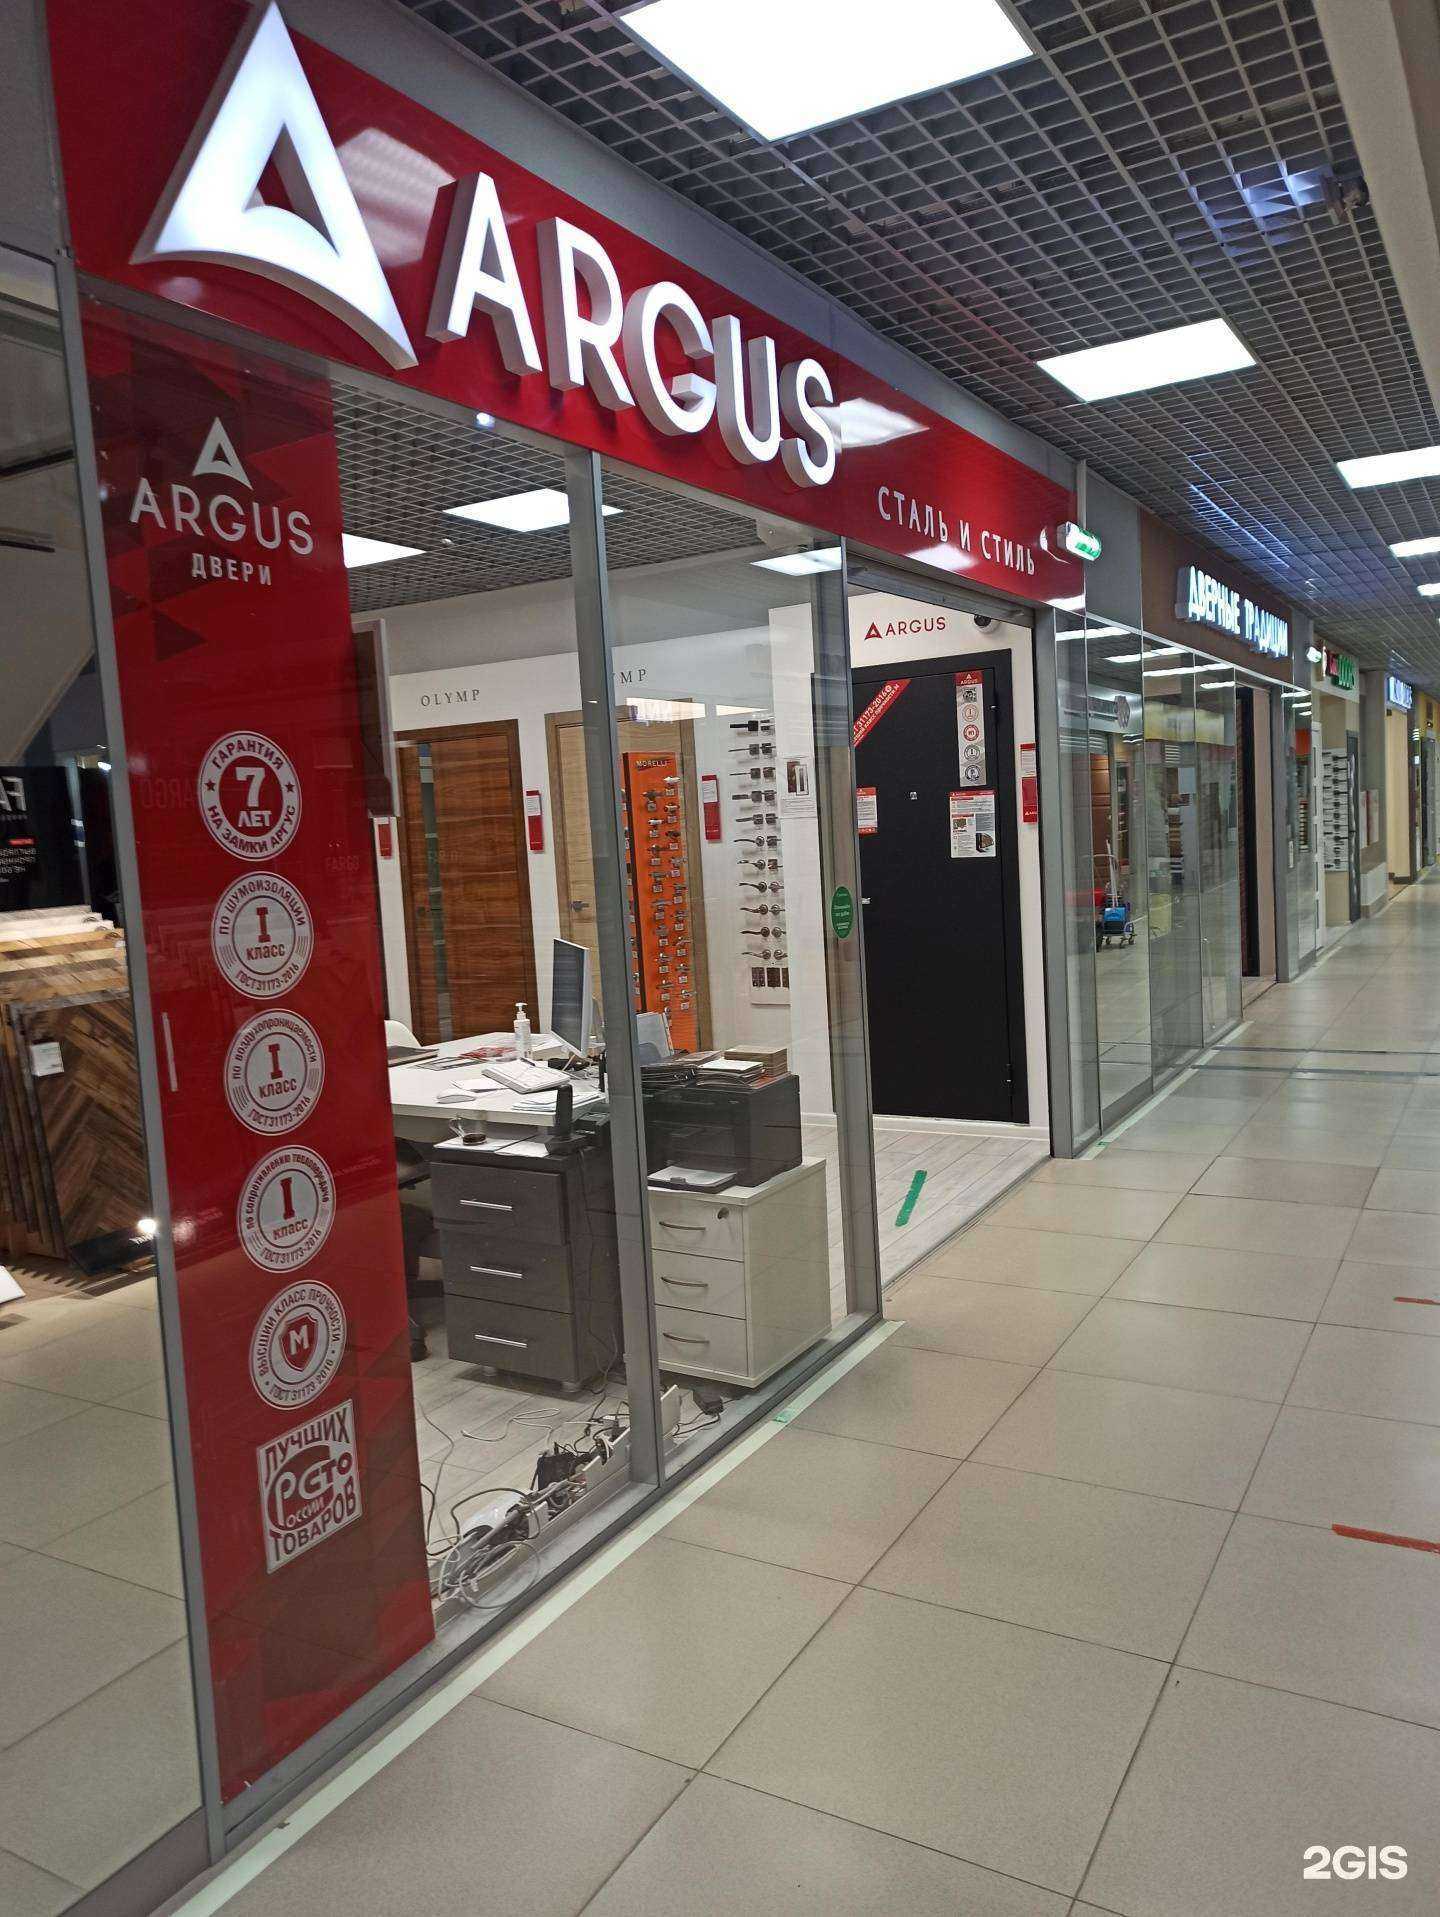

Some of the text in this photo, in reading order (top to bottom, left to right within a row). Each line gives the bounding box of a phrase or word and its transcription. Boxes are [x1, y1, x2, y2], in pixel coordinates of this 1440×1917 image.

[426, 171, 837, 487] ARGUS
[129, 477, 315, 555] ARGUS
[877, 486, 1036, 576] СТАЛЬ И СТИЛЬ
[190, 553, 272, 586] ДВЕРИ
[885, 616, 946, 637] ARGUS
[420, 688, 481, 707] OLYMP
[211, 739, 284, 770] ГАРАНТИЯ
[235, 766, 266, 807] 7
[208, 805, 296, 853] НА ЗАМКИ АРГУС
[238, 810, 272, 827] ЛЕТ
[219, 880, 306, 935] ПО ШУМОИЗОЛЯЦИИ
[246, 944, 286, 960] класс
[258, 1078, 297, 1099] класс
[272, 1219, 308, 1240] класс
[274, 1289, 306, 1316] КЛАСС
[308, 1289, 341, 1342] ПРОЧНОСТИ
[264, 1407, 351, 1489] ЛУЧШИХ
[269, 1475, 356, 1562] ТОВАРОВ
